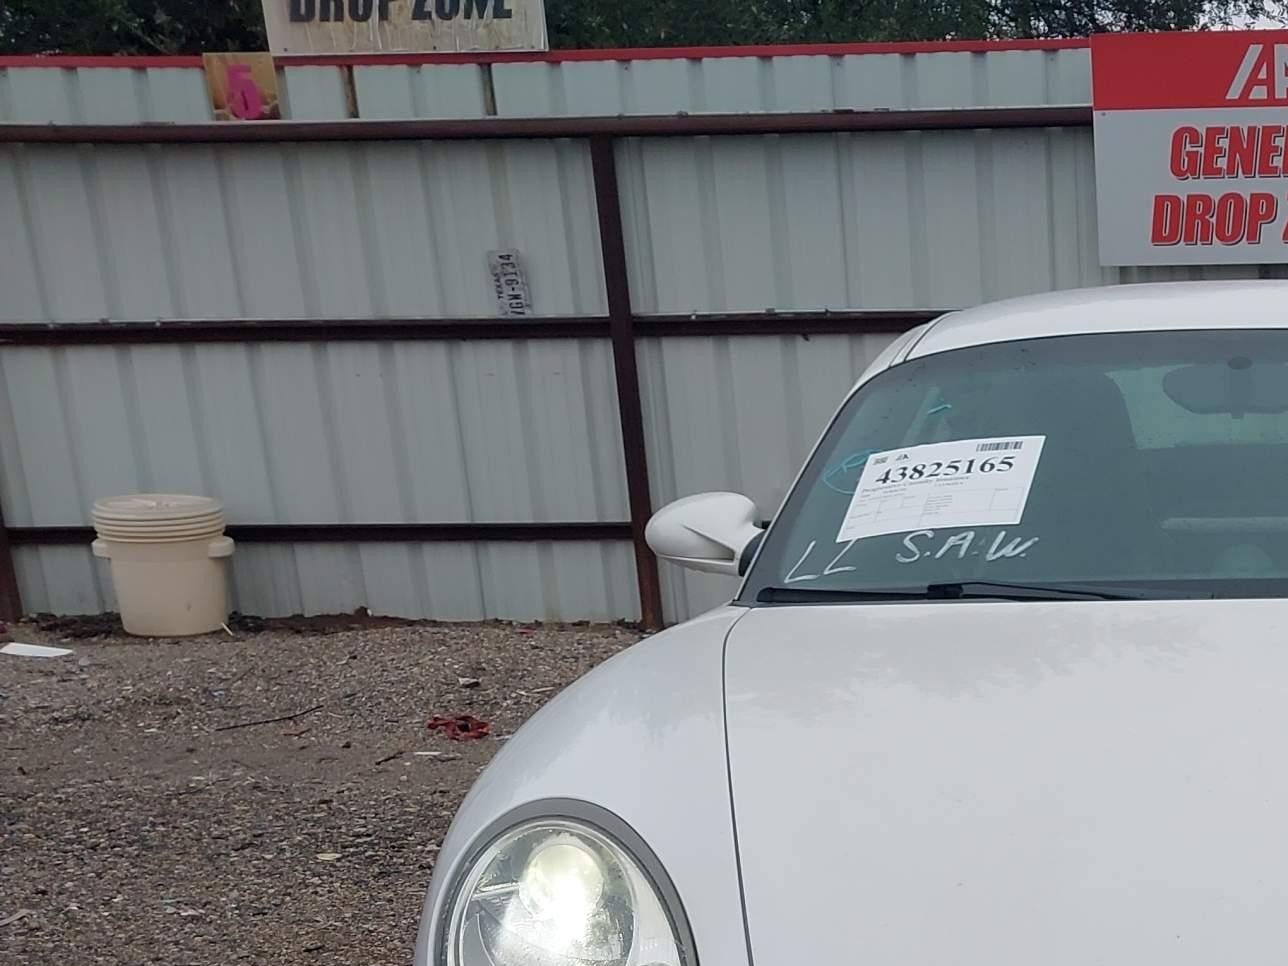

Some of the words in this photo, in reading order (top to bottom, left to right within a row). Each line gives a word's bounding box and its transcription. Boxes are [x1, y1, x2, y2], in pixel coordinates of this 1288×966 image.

[289, 0, 395, 22] DROP
[412, 0, 513, 20] ZONE
[1151, 192, 1278, 247] DROP
[492, 271, 504, 299] TEXAS
[874, 455, 1016, 485] 43825165
